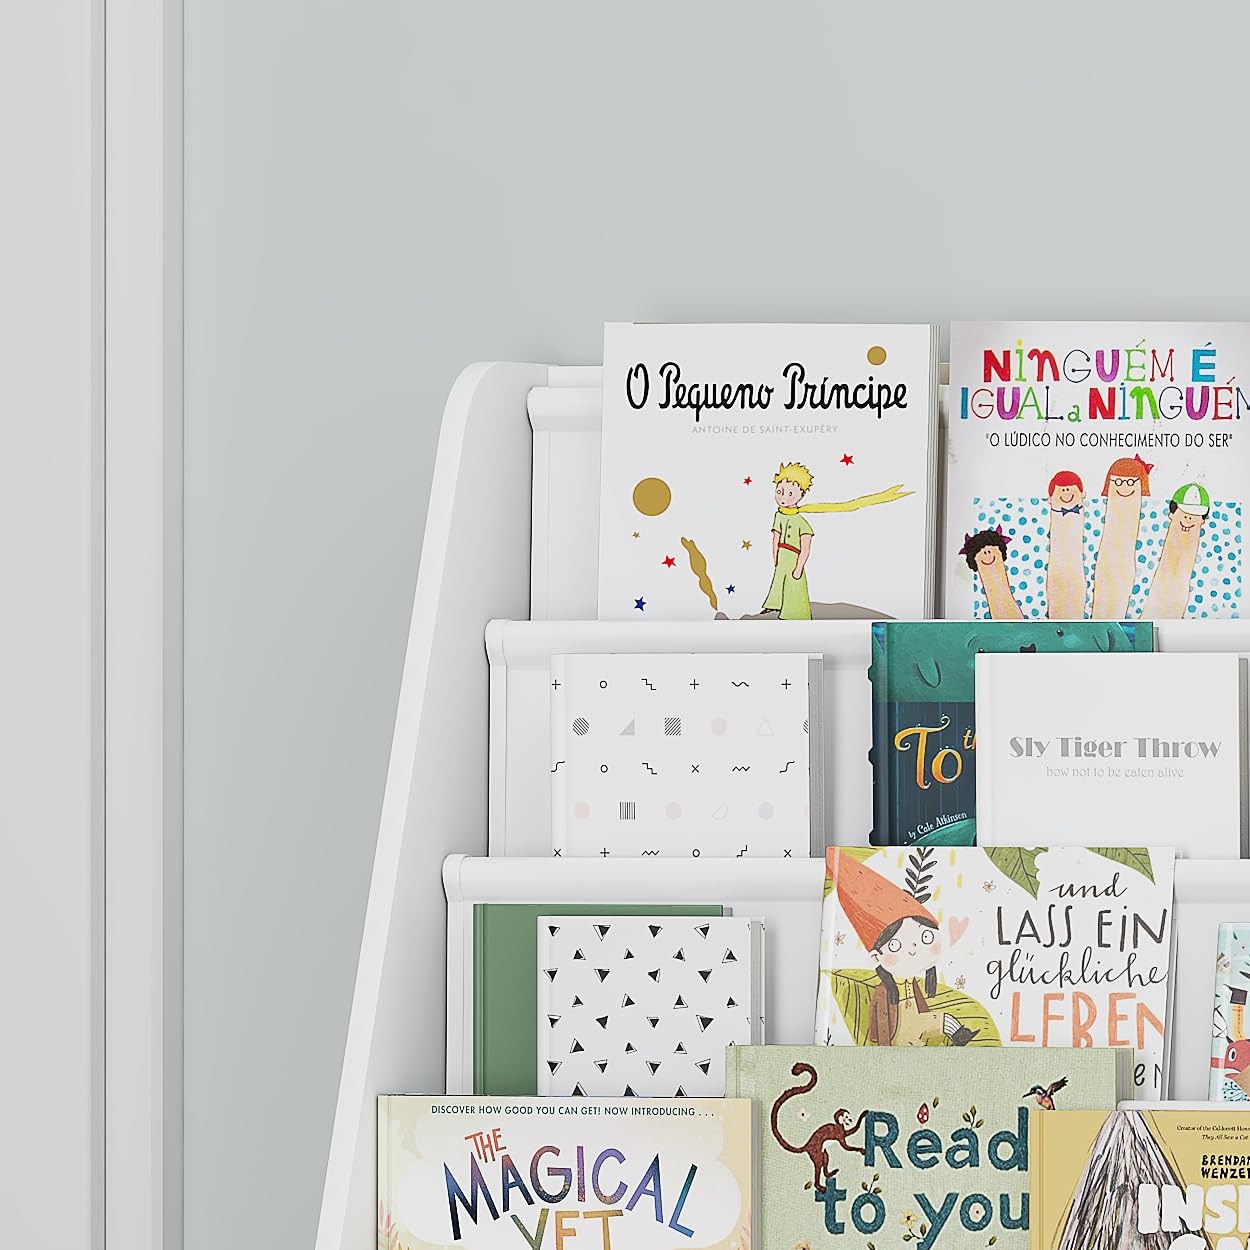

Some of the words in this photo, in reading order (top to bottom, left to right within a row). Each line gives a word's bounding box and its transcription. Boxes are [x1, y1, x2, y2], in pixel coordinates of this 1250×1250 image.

[1191, 342, 1216, 382] É
[626, 362, 650, 409] O
[658, 361, 774, 422] Pequeno
[782, 362, 908, 419] Príncipe
[960, 386, 1064, 420] IGUAL
[1068, 405, 1081, 422] a
[692, 425, 738, 434] ANTOINE
[742, 425, 756, 434] DE
[1004, 431, 1050, 447] LÚDICO
[1055, 432, 1075, 447] NO
[1080, 432, 1180, 448] CONHECIMENTO
[1185, 433, 1204, 448] DO
[894, 714, 962, 790] To
[1008, 736, 1050, 758] Sly
[1056, 736, 1126, 758] Tiger
[1133, 736, 1222, 758] Throw
[1046, 766, 1070, 777] how
[1072, 768, 1090, 777] not
[1094, 768, 1104, 777] to
[1108, 767, 1120, 777] be
[1124, 768, 1154, 778] eaten
[1158, 768, 1184, 778] alive
[917, 822, 934, 834] Cale
[936, 812, 968, 828] Atkinson
[1049, 872, 1128, 899] und
[997, 905, 1073, 948] LASS
[986, 947, 1168, 999] glückliche
[431, 1105, 476, 1115] DISCOVER
[478, 1106, 502, 1115] HOW
[504, 1106, 533, 1115] GOOD
[536, 1106, 556, 1115] YOU
[558, 1106, 579, 1116] CAN
[581, 1106, 601, 1116] GET!
[604, 1106, 628, 1116] NOW
[630, 1106, 696, 1117] INTRODUCING
[464, 1128, 507, 1163] THE
[864, 1107, 1029, 1171] Read
[443, 1145, 698, 1241] MAGICAL
[815, 1178, 886, 1235] to
